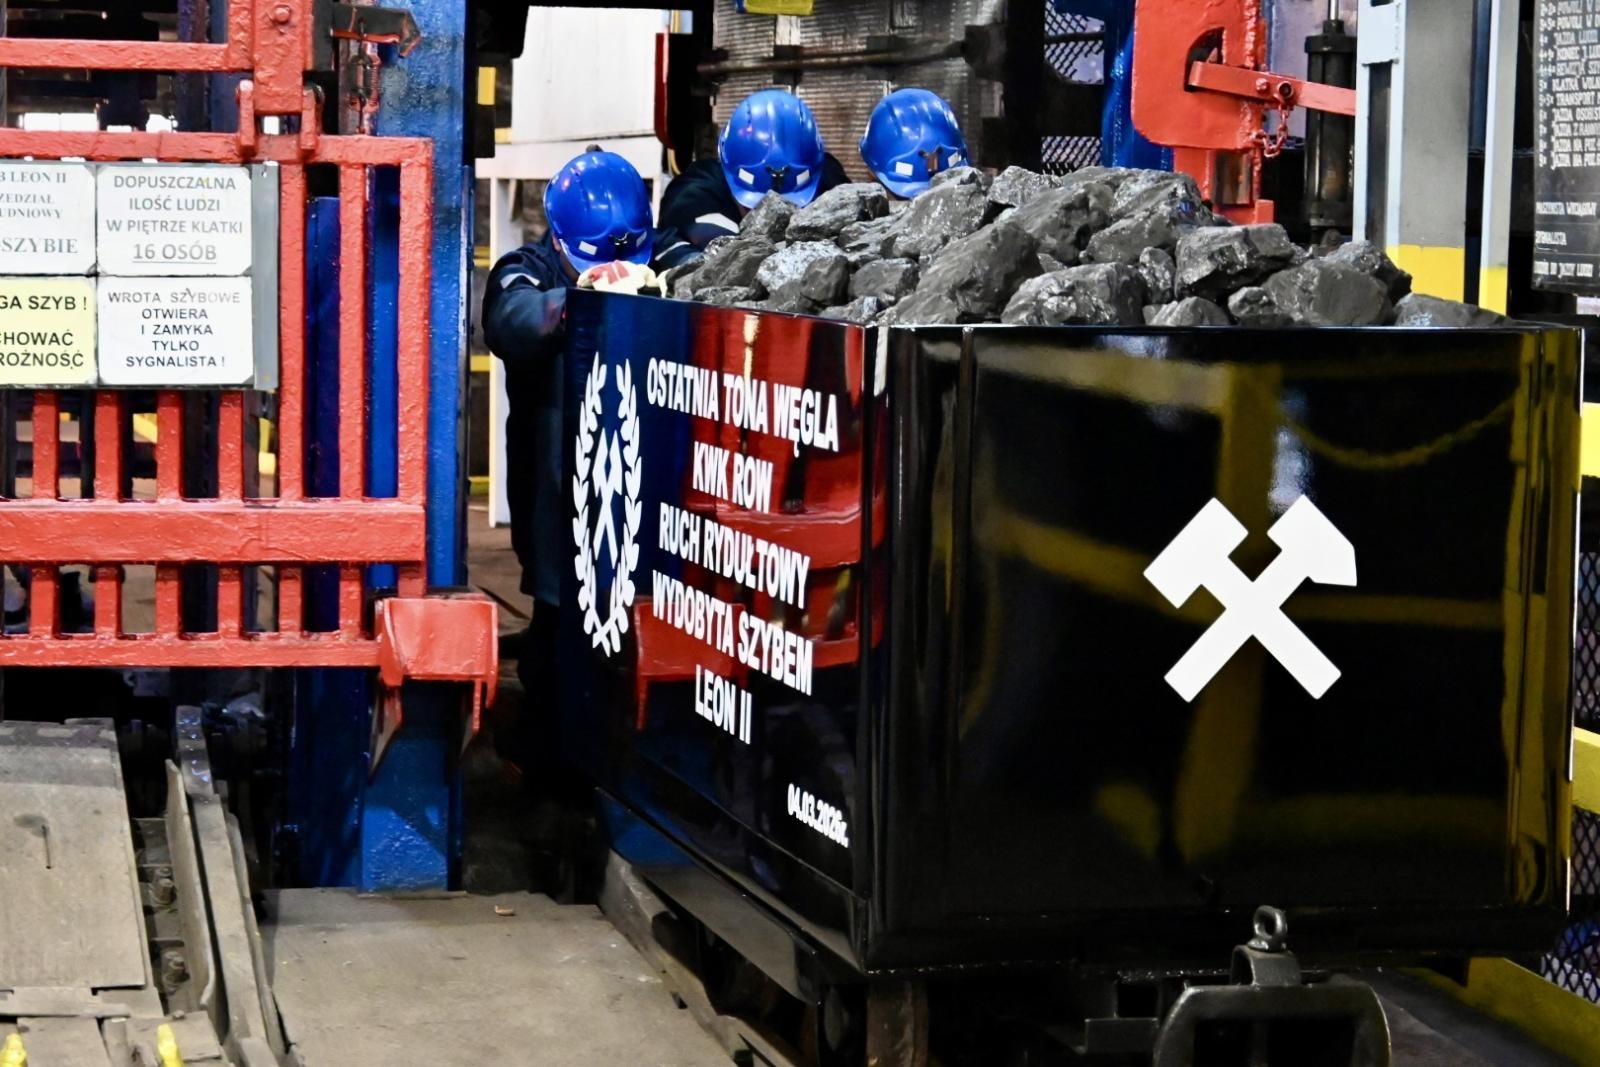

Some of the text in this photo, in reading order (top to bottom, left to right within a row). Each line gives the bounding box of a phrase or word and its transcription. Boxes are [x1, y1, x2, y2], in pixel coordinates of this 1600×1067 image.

[11, 171, 51, 183] LEON
[57, 173, 67, 183] II
[114, 175, 237, 190] DOPUSZCZALNA
[129, 195, 220, 212] ILOŚĆ LUDZI
[106, 219, 243, 235] W PIĘTRZE KLATKI
[1, 238, 79, 254] SZYBIE
[133, 240, 217, 261] 16 OSÓB
[28, 295, 76, 310] SZYB
[108, 291, 240, 304] WROTA SZYBOWE
[141, 308, 208, 320] OTWIERA
[141, 324, 214, 336] I ZAMYKA
[152, 340, 200, 352] TYLKO
[126, 356, 217, 368] SYGNALISTA
[647, 357, 839, 458] OSTATNIA TONA WĘGLA
[692, 440, 773, 514] KWK ROW
[658, 502, 810, 609] RUCH RYDUŁTOWY
[652, 569, 813, 696] WYDOBYTA SZYBEM
[695, 664, 752, 744] LEON II
